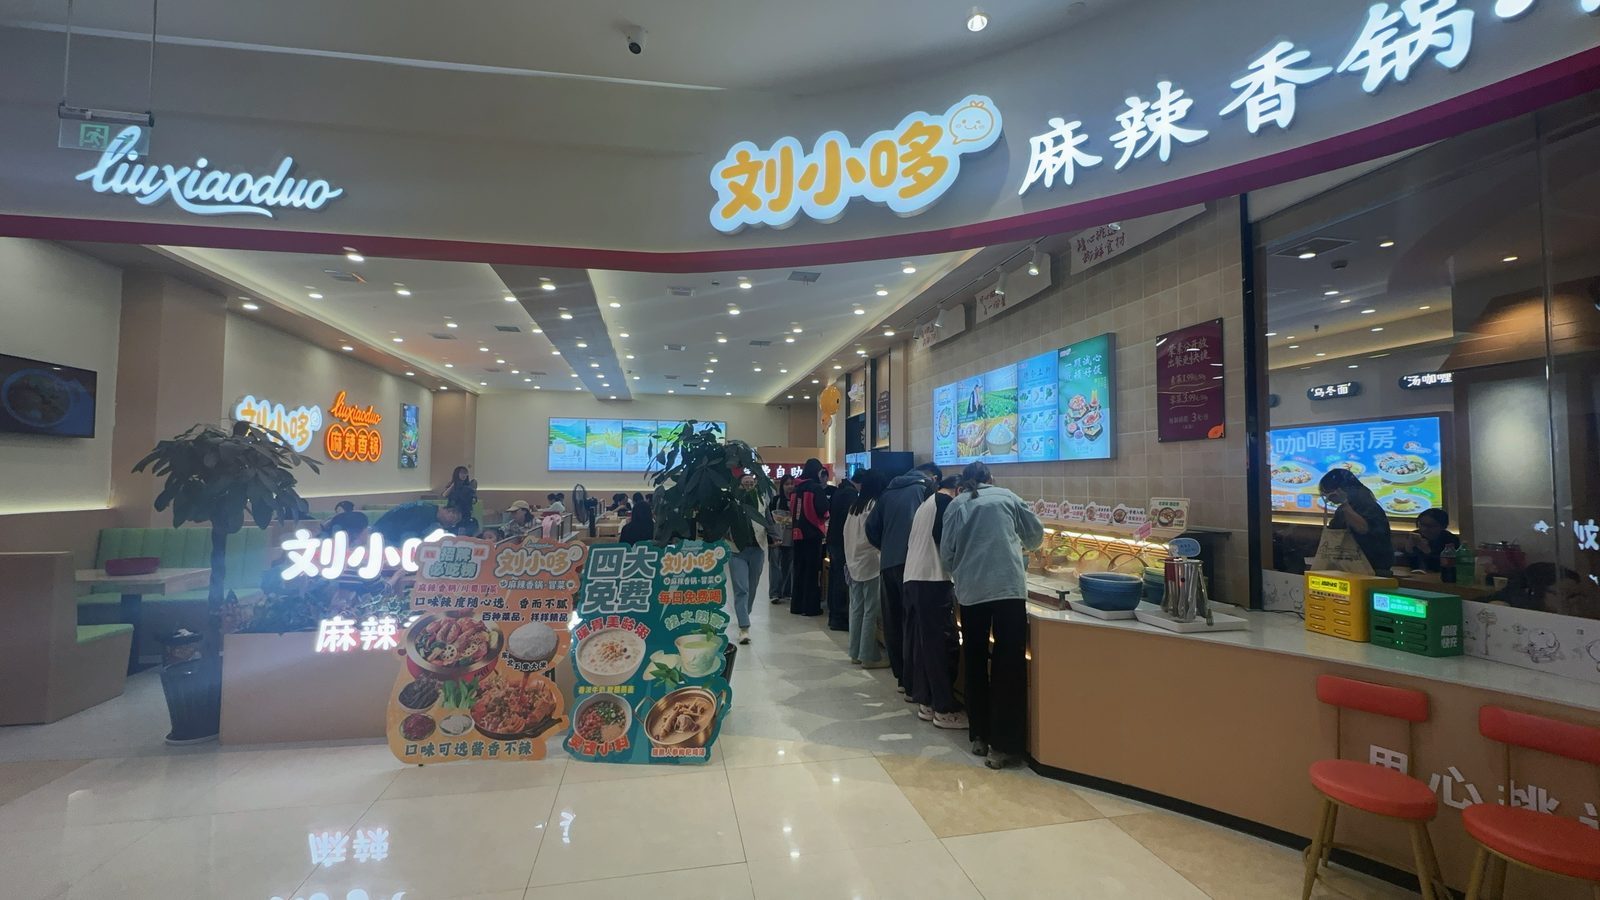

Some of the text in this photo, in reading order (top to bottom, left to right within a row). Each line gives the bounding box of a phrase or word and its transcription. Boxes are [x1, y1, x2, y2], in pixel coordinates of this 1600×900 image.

[75, 125, 343, 218] liuxiaoduo
[720, 118, 951, 220] 刘小哆
[330, 391, 382, 428] liuxiaoduo
[330, 430, 380, 456] 麻辣香锅
[1275, 426, 1397, 455] 咖喱厨房
[498, 550, 570, 577] 刘小哆
[588, 546, 658, 580] 四大
[662, 551, 718, 576] 刘小哆
[582, 579, 653, 613] 免费
[404, 741, 533, 758] 口味可选酱香不辣
